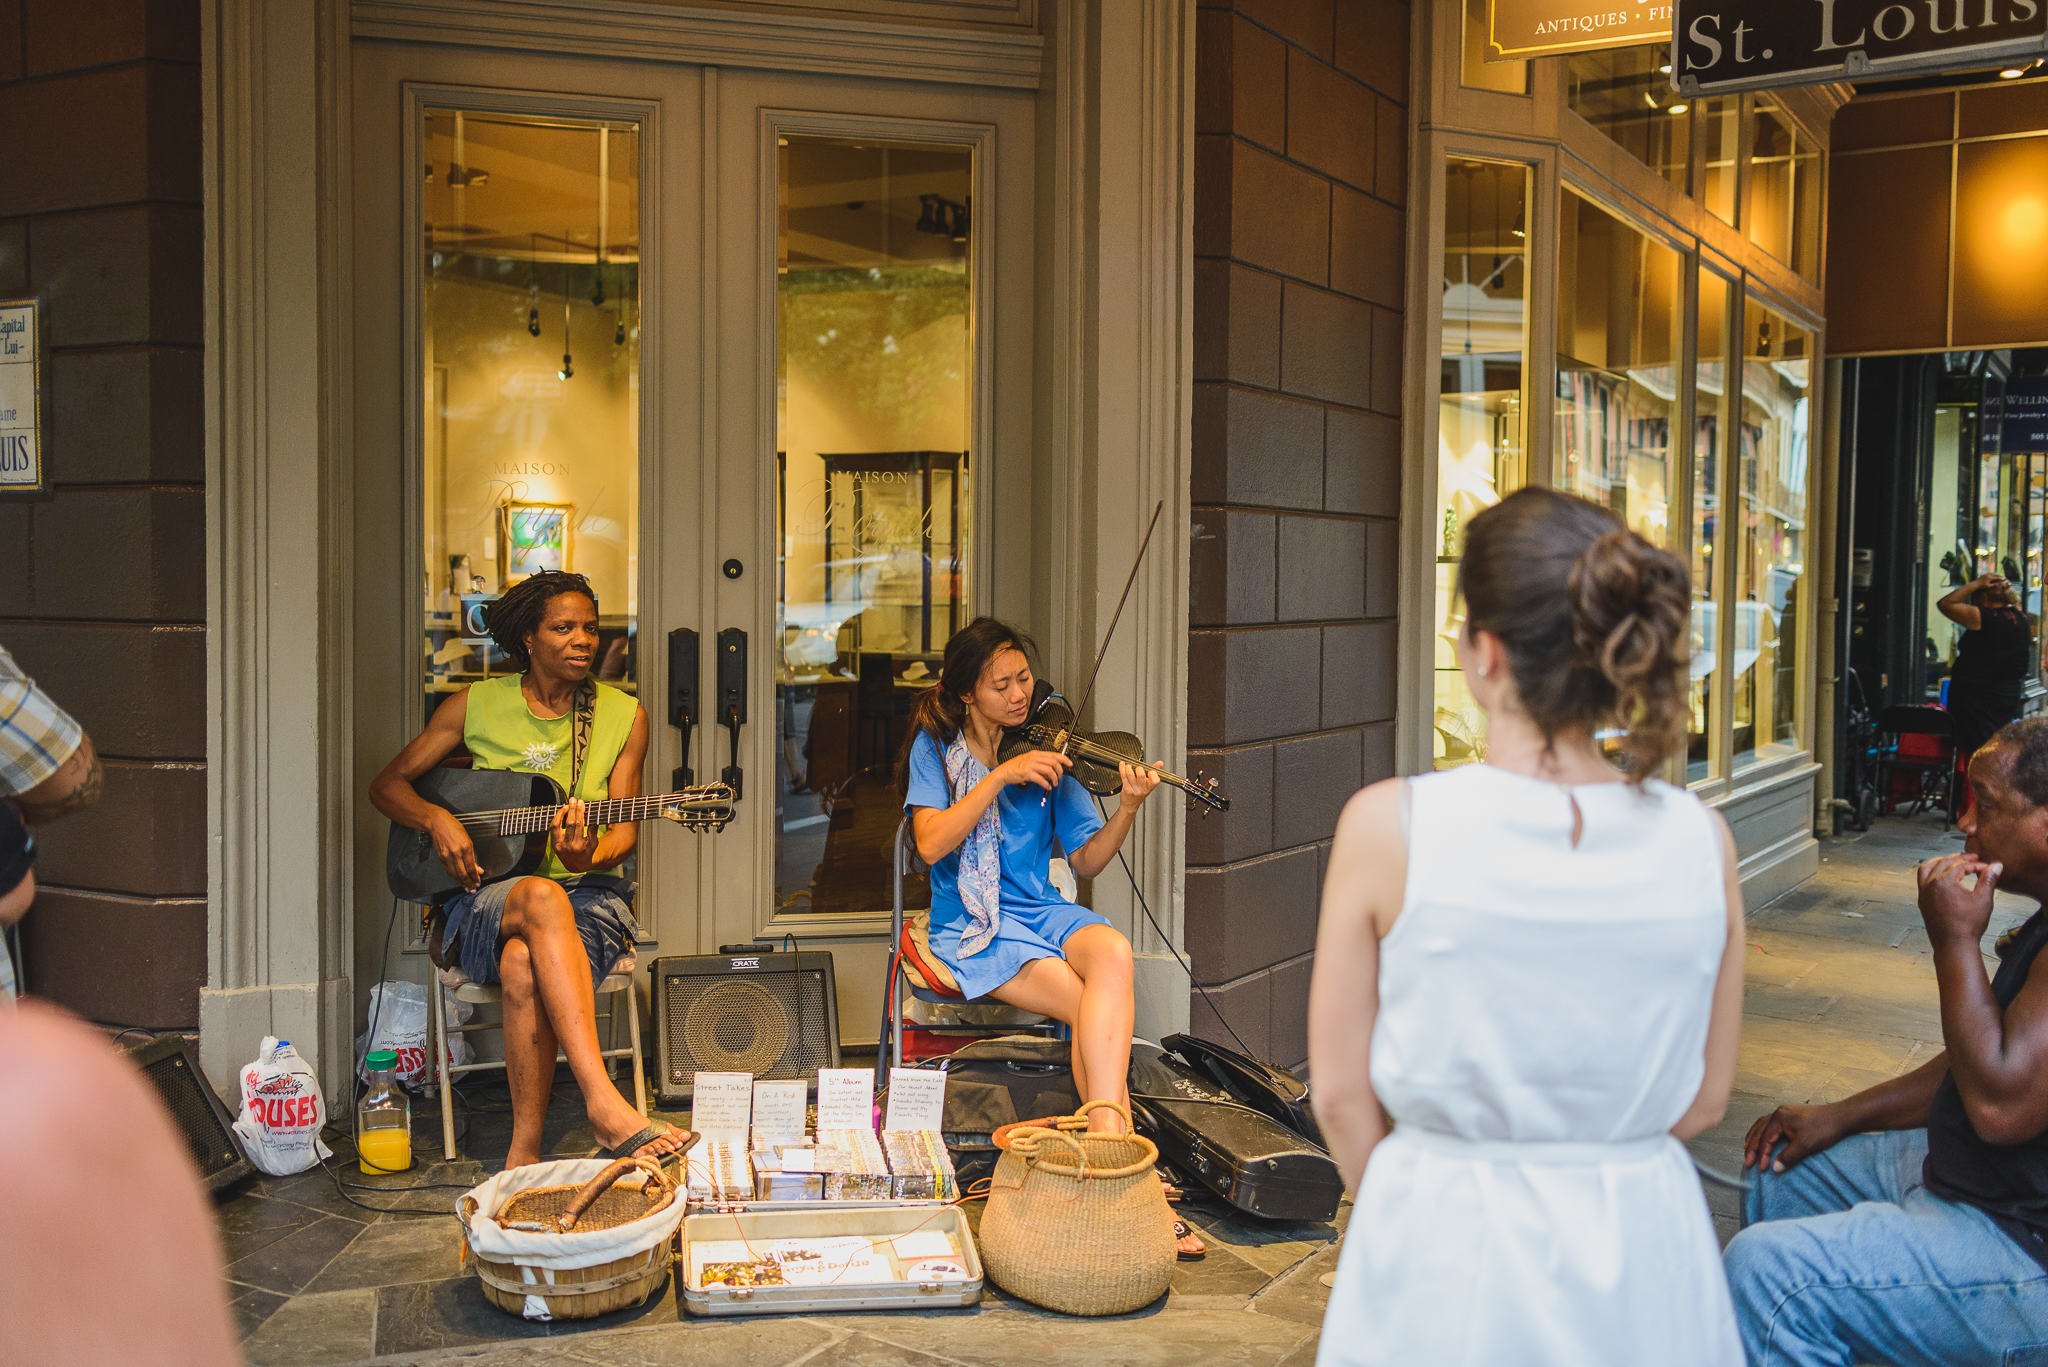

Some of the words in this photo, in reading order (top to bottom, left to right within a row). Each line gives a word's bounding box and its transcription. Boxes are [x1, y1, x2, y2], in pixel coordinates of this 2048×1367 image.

[1535, 11, 1627, 34] ANTIQUES
[1686, 14, 1773, 69] St.
[1813, 0, 2038, 51] Louis
[0, 315, 25, 339] apital
[0, 435, 29, 472] UIS
[494, 462, 571, 476] MAISON
[448, 472, 615, 568] Royale
[696, 1083, 722, 1091] Street
[726, 1083, 751, 1092] Takes
[761, 1091, 772, 1099] On
[817, 1260, 826, 1273] &
